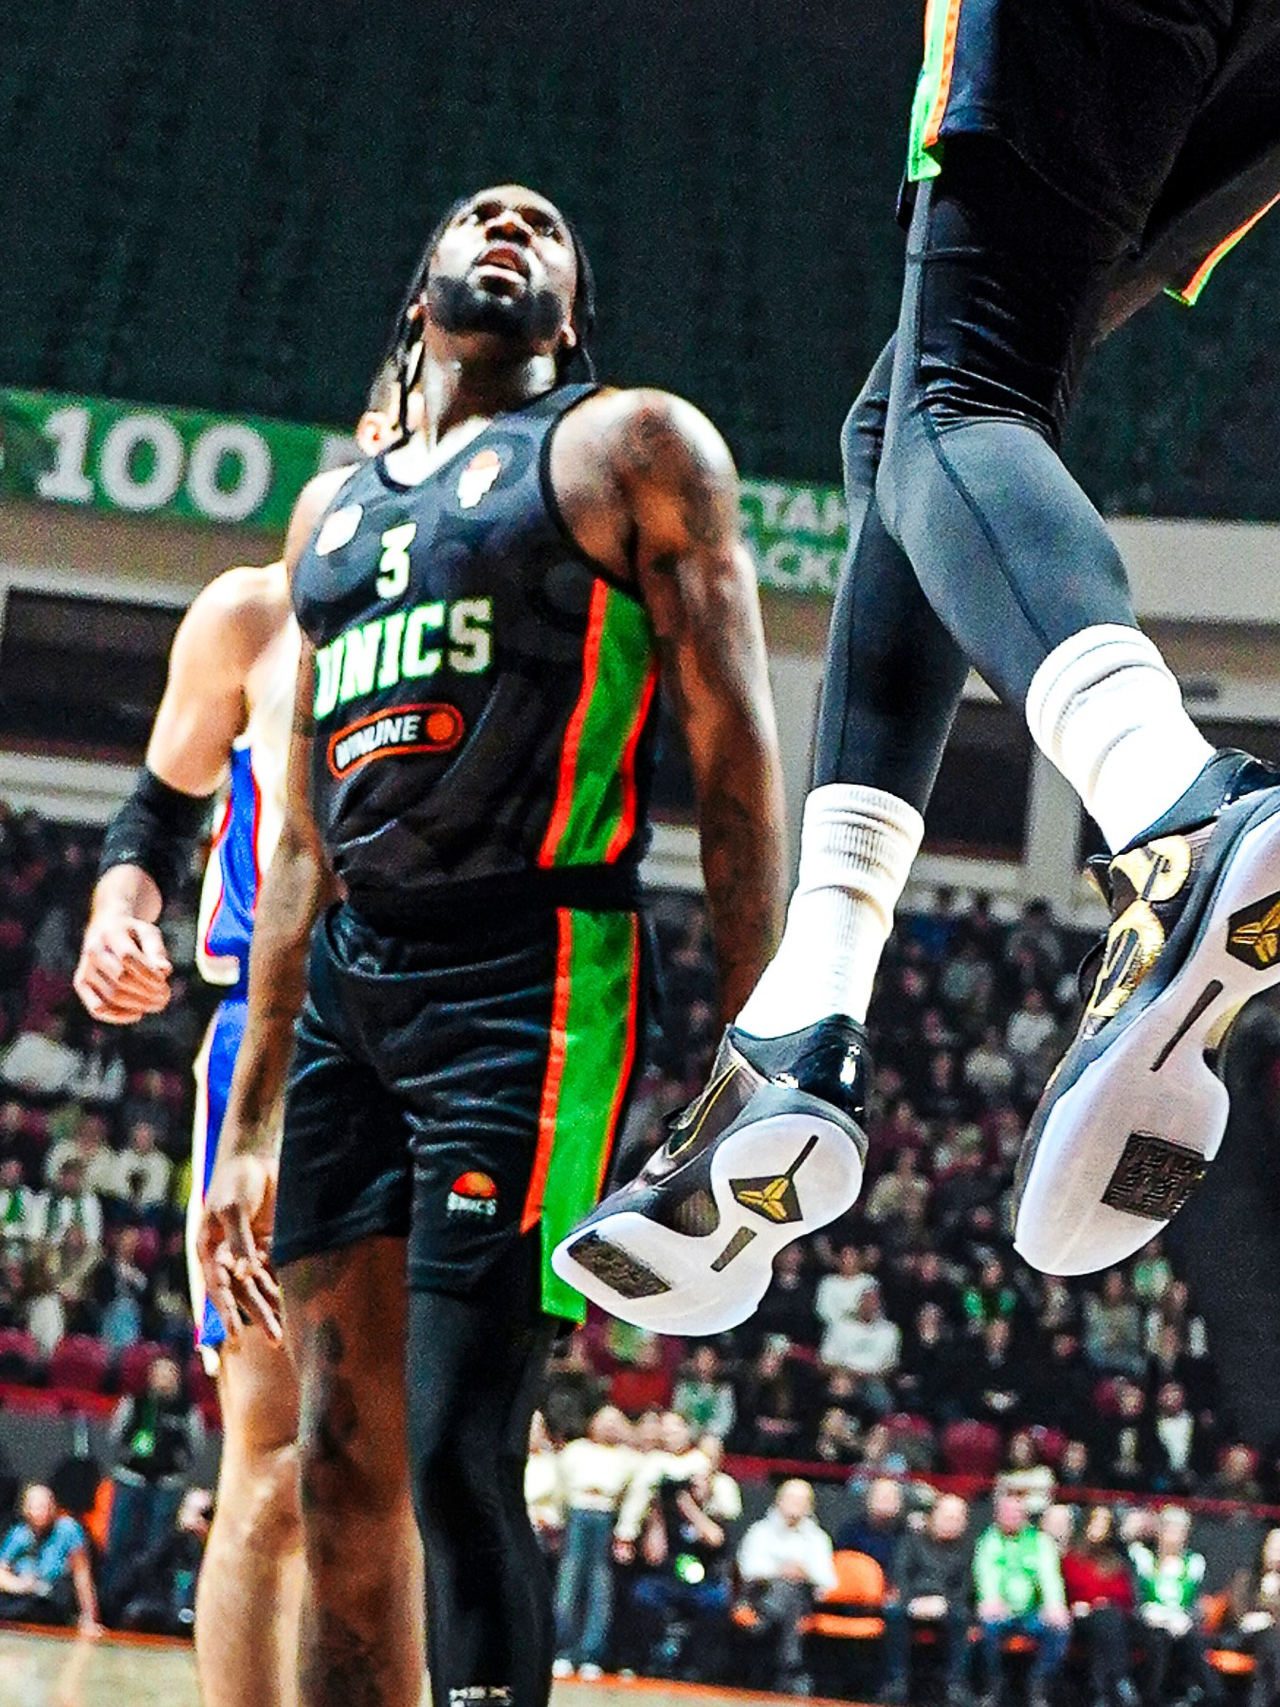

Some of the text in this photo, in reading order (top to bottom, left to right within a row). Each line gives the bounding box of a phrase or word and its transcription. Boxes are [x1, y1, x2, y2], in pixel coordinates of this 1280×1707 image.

[36, 405, 272, 523] 100
[375, 521, 418, 600] 3
[312, 595, 494, 721] UNICS
